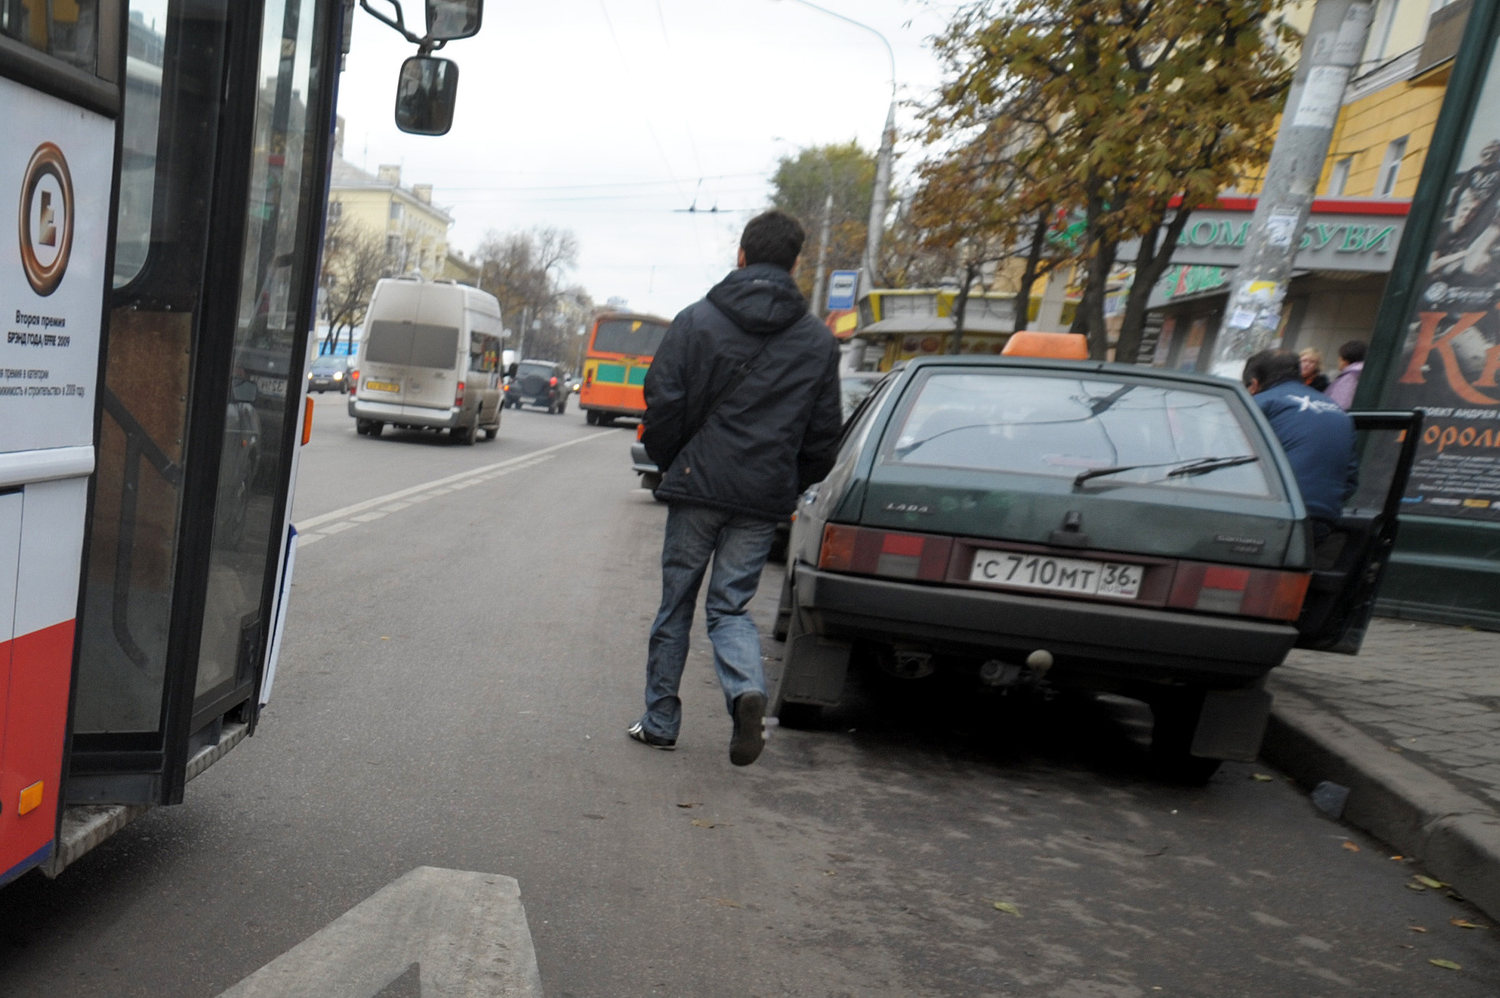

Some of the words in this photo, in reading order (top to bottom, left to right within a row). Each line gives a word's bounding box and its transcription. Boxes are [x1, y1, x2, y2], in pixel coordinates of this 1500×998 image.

[15, 309, 40, 328] Вторая
[41, 316, 66, 330] премия
[886, 502, 929, 513] LADA
[1103, 564, 1131, 587] 36
